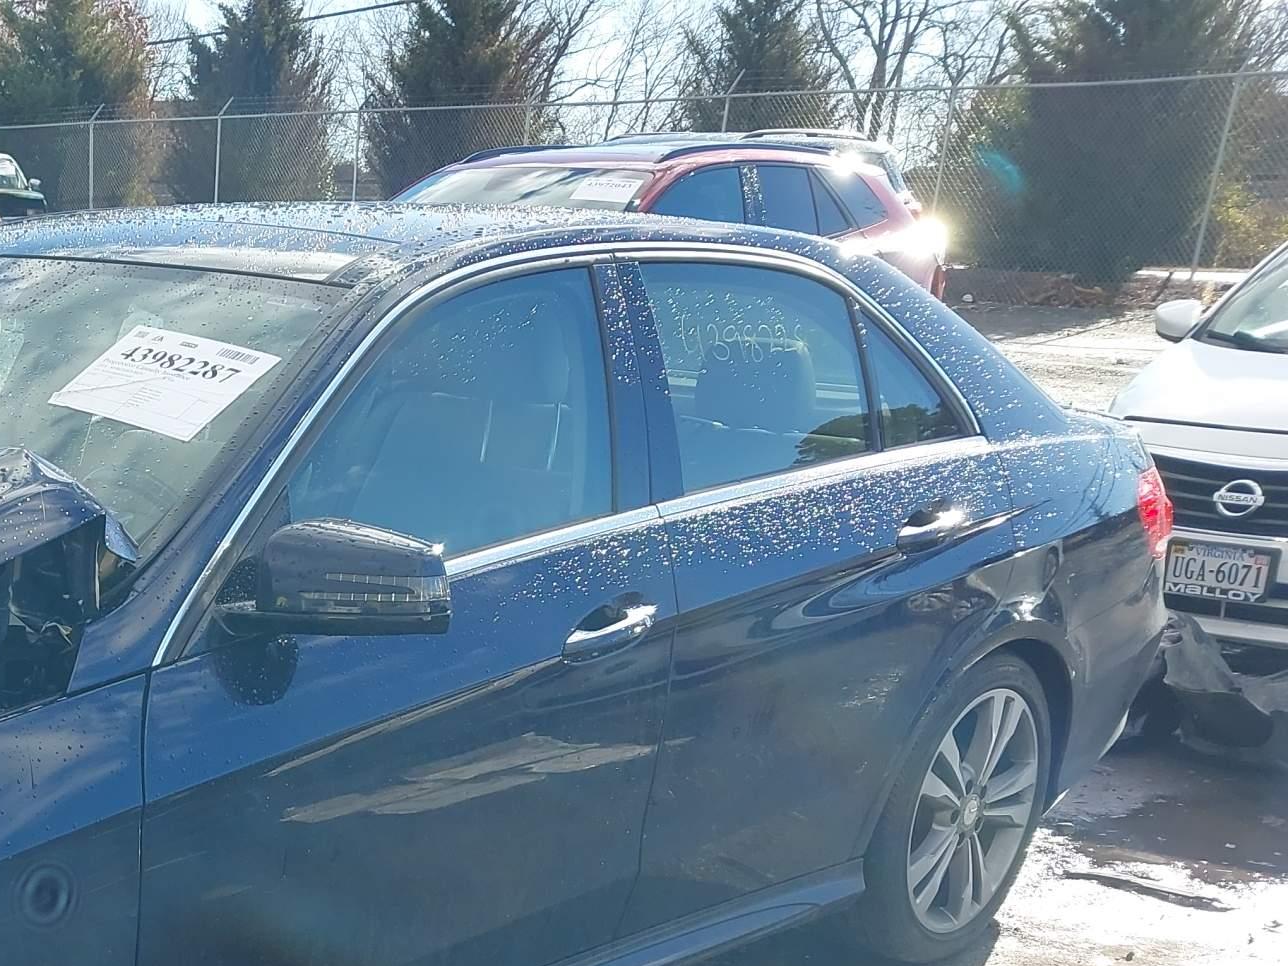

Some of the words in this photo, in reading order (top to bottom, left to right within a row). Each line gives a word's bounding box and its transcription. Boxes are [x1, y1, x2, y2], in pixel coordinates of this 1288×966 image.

[120, 345, 242, 383] 43982287
[1217, 494, 1257, 503] NISSAN
[1194, 546, 1246, 562] VIRGINIA
[1172, 556, 1263, 588] UGA-6071
